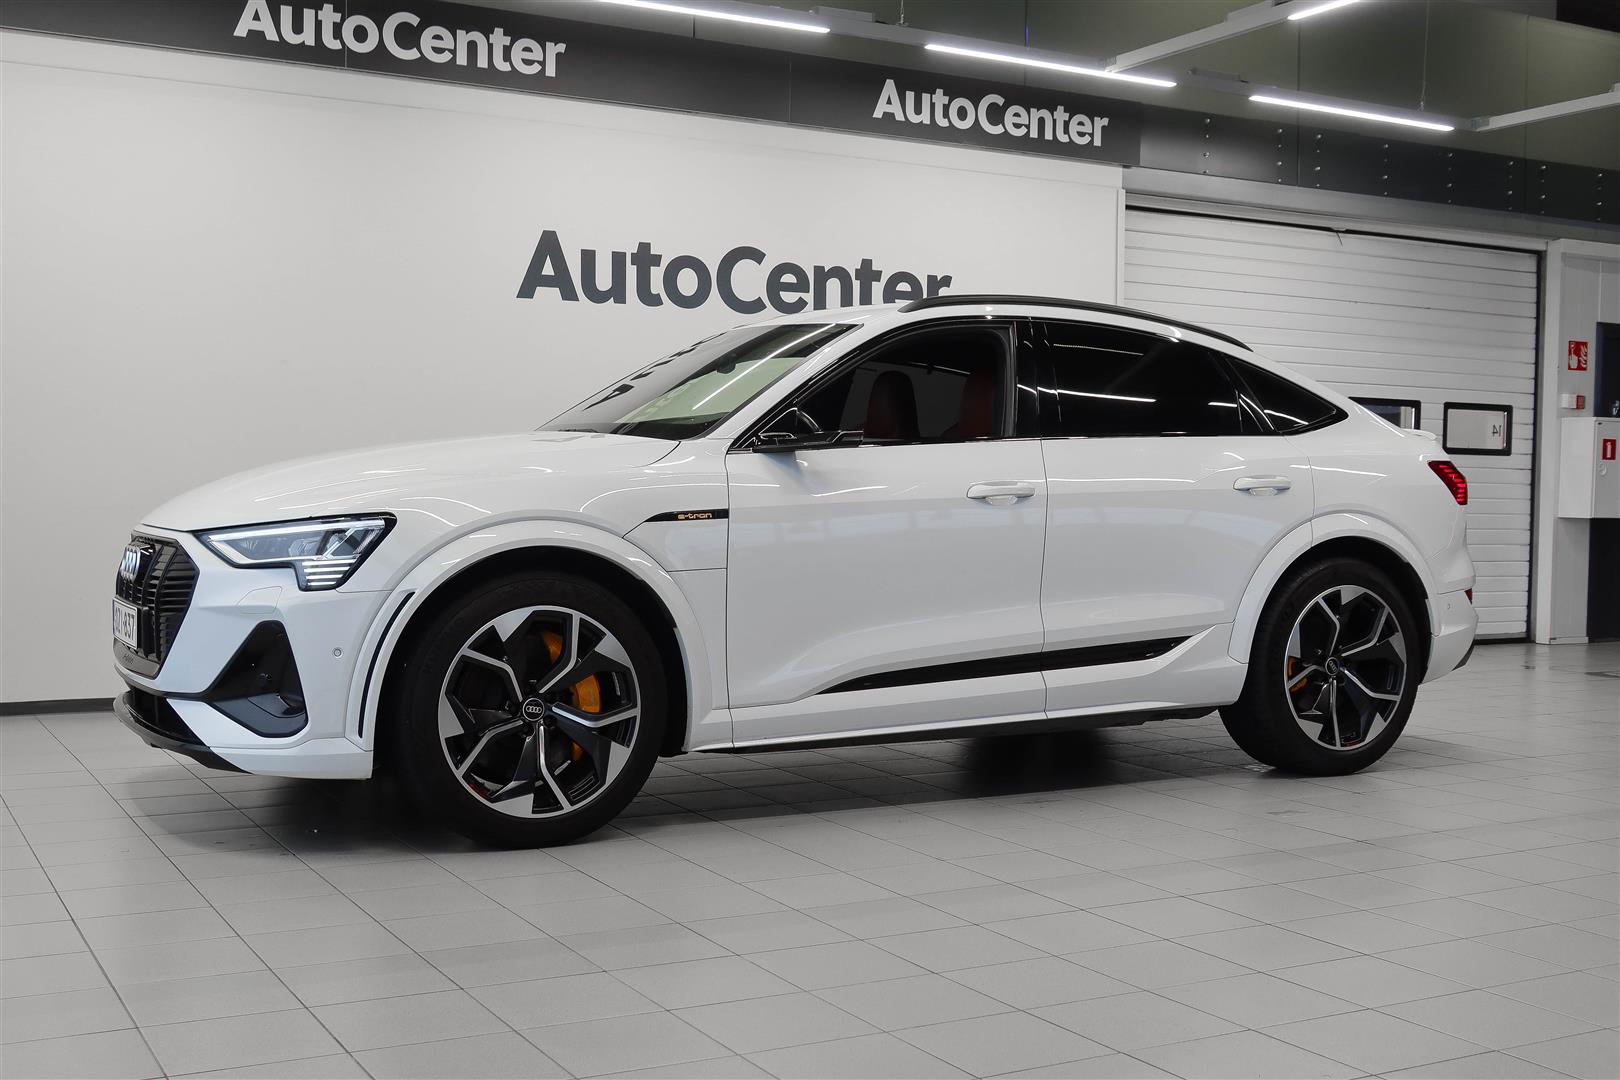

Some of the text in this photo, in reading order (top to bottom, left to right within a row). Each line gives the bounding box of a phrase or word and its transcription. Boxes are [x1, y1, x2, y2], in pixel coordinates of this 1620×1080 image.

[233, 0, 566, 77] AutoCenter
[873, 79, 1109, 146] AutoCenter
[516, 230, 952, 314] AutoCenter
